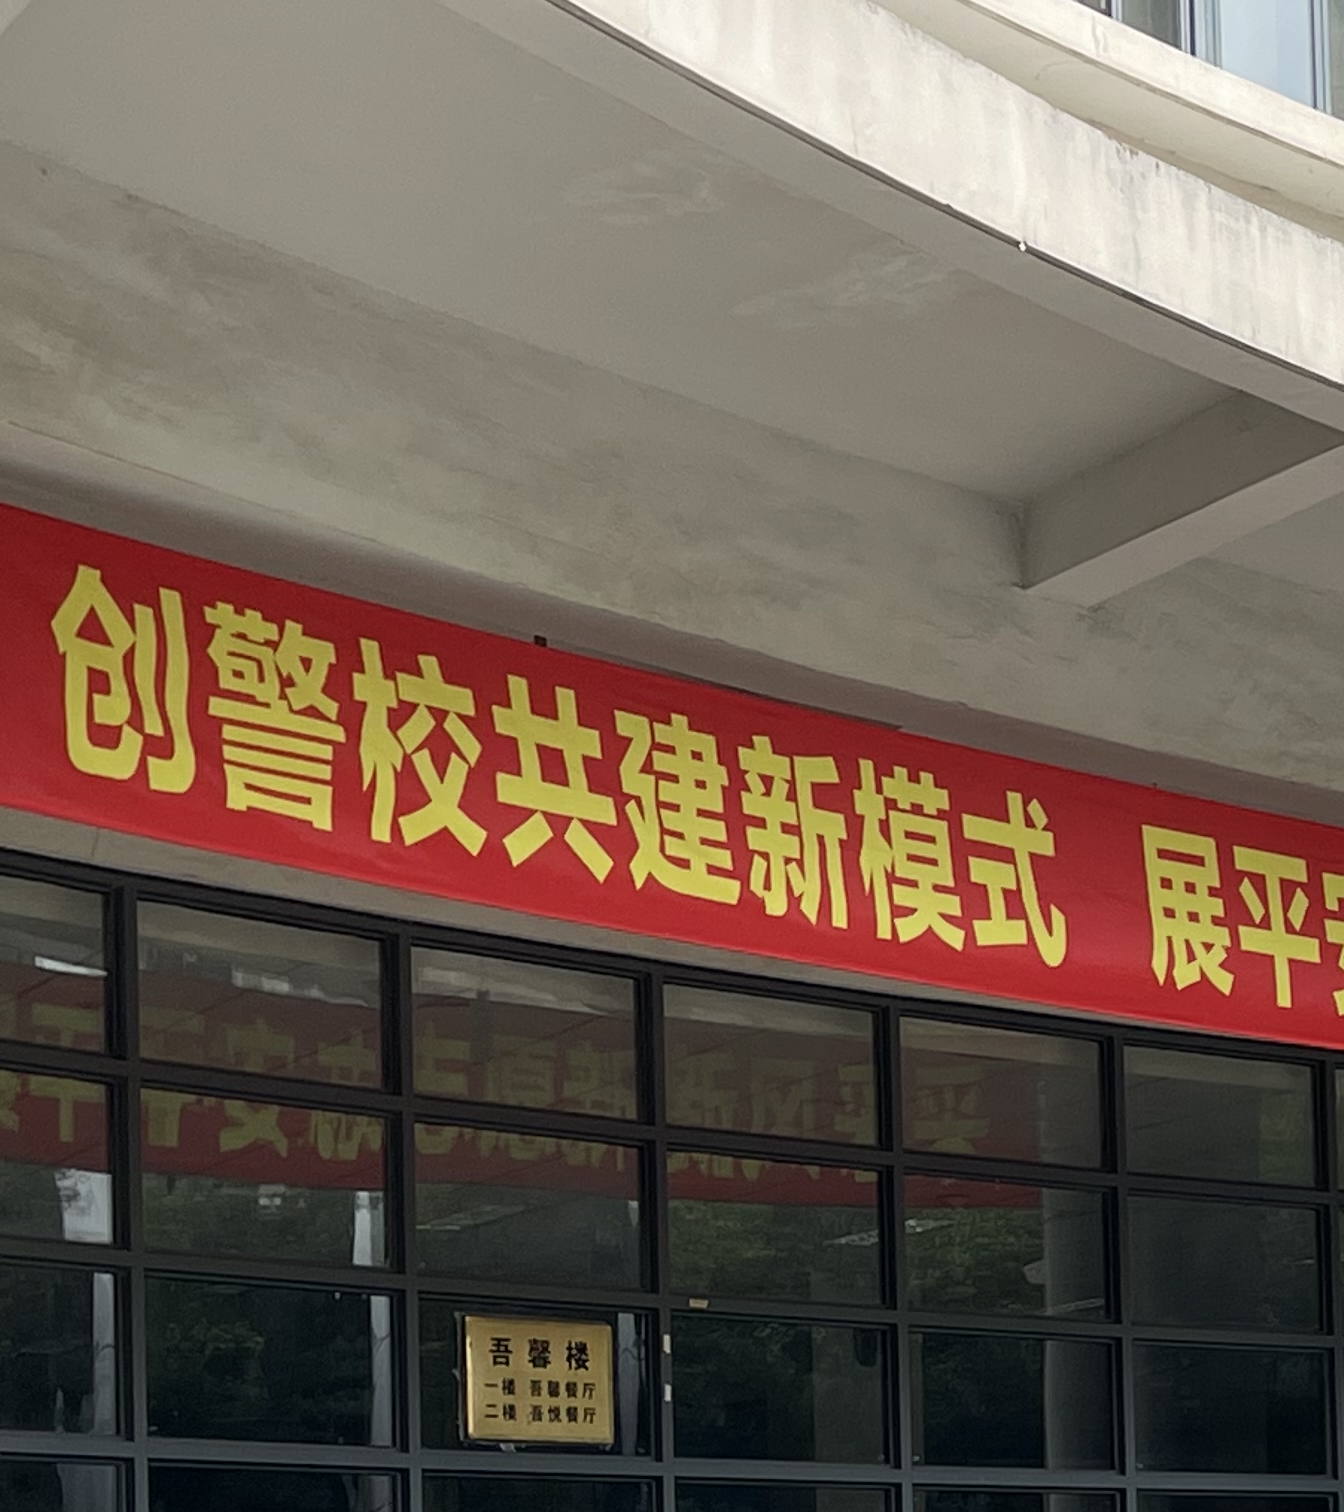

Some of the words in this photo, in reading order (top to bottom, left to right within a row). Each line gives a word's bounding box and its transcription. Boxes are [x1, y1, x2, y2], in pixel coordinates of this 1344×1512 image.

[51, 564, 1068, 967] 创警校共建新模式
[489, 1336, 590, 1371] 吾馨楼
